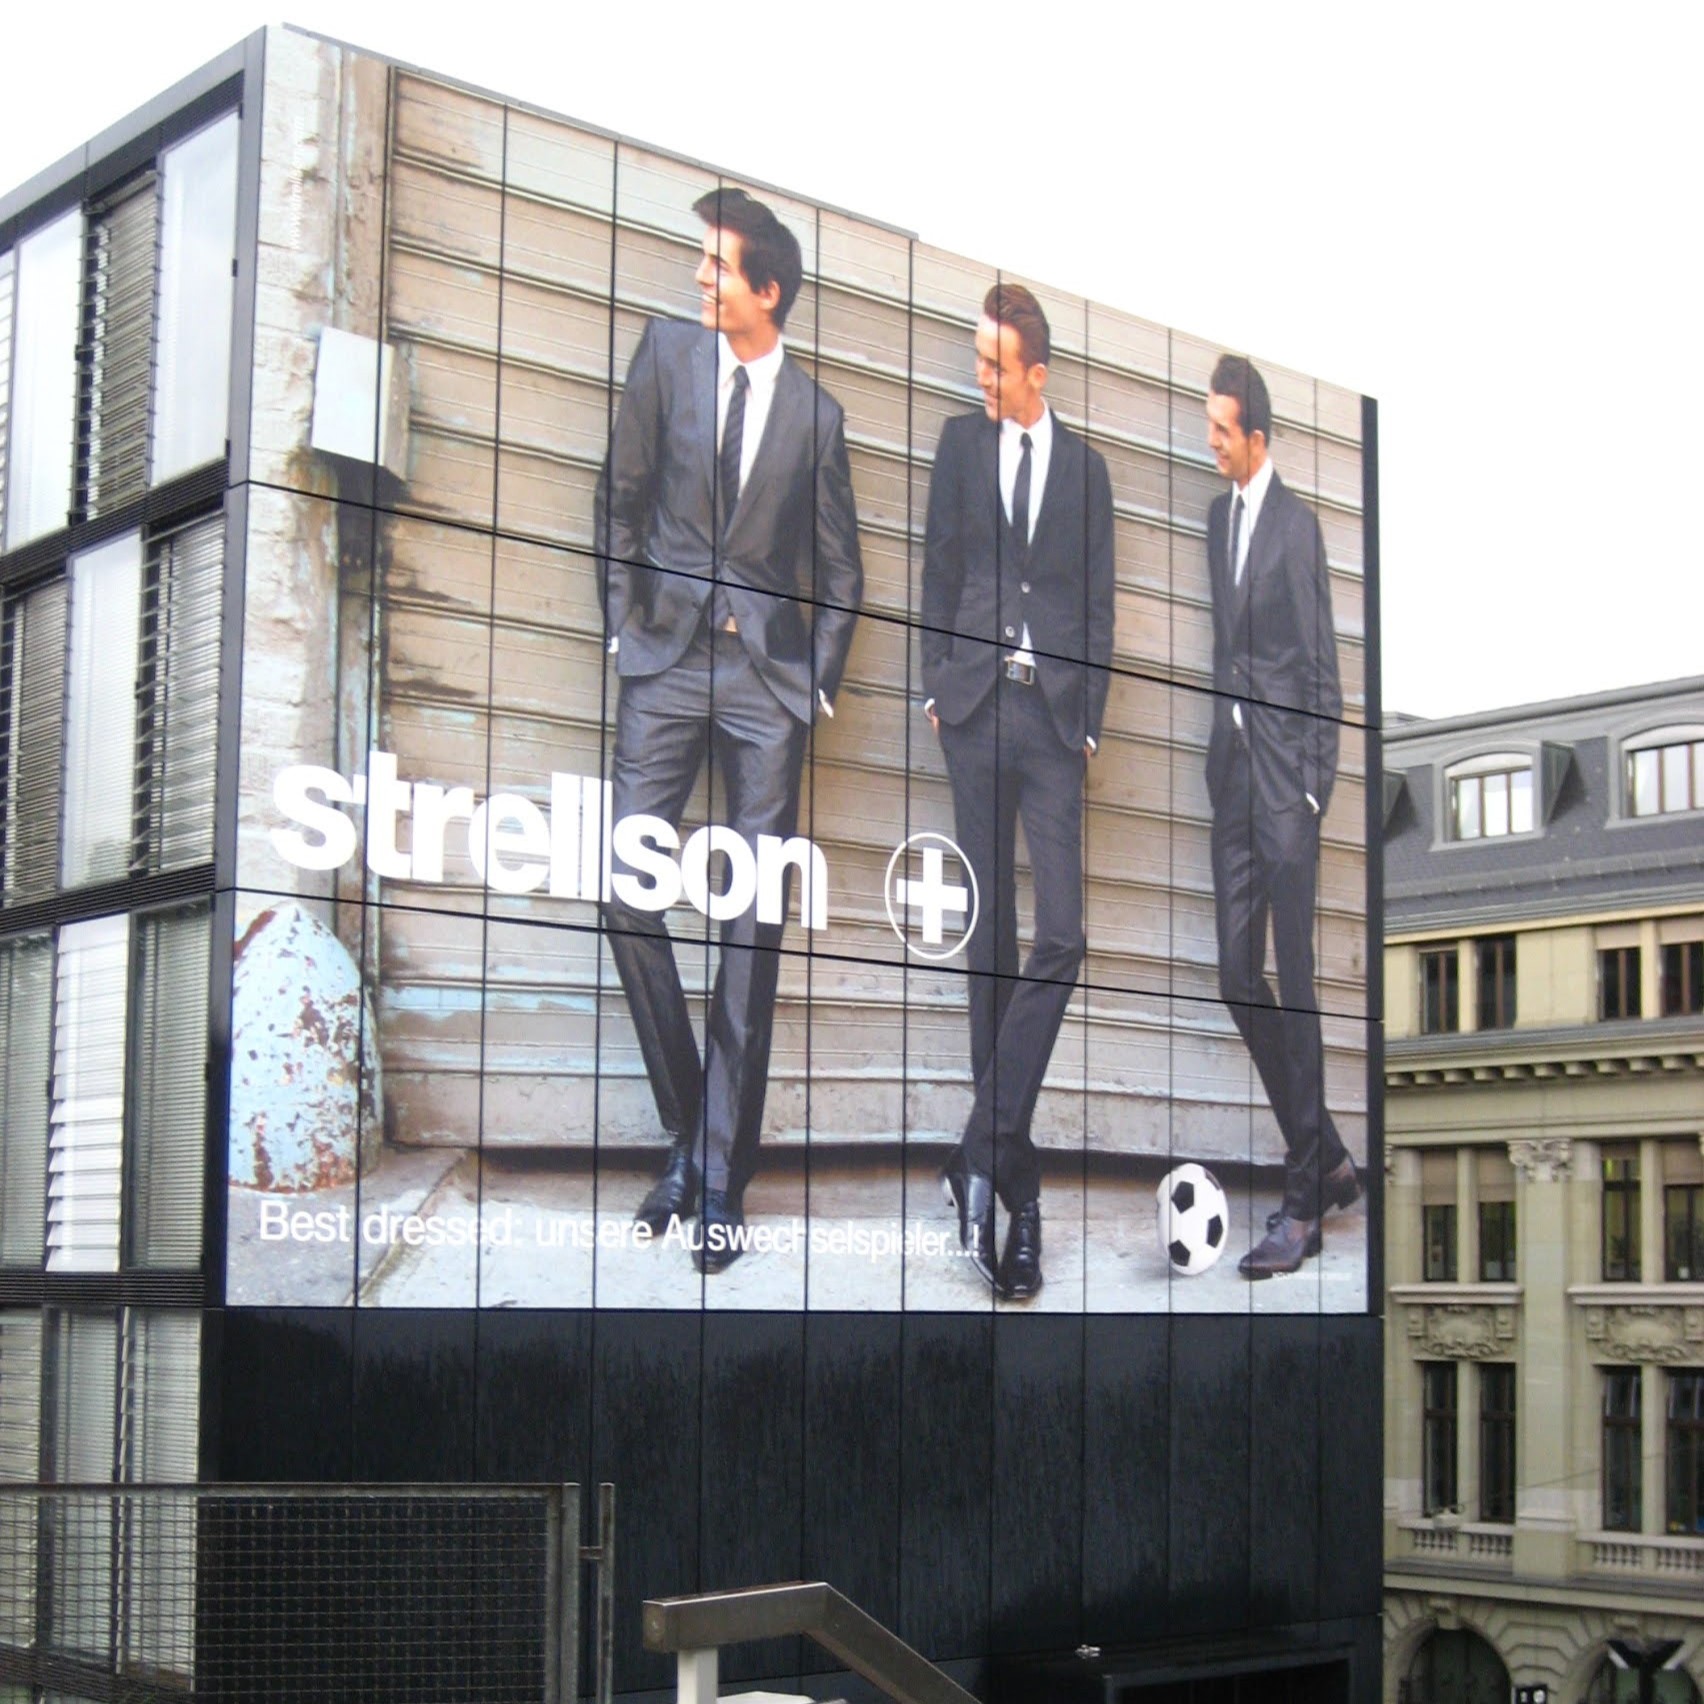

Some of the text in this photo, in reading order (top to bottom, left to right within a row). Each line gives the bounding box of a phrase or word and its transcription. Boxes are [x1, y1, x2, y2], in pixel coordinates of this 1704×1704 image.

[271, 751, 828, 930] strellson
[259, 1200, 350, 1243] Best
[363, 1204, 522, 1247] dressed:
[535, 1216, 653, 1250] unsere
